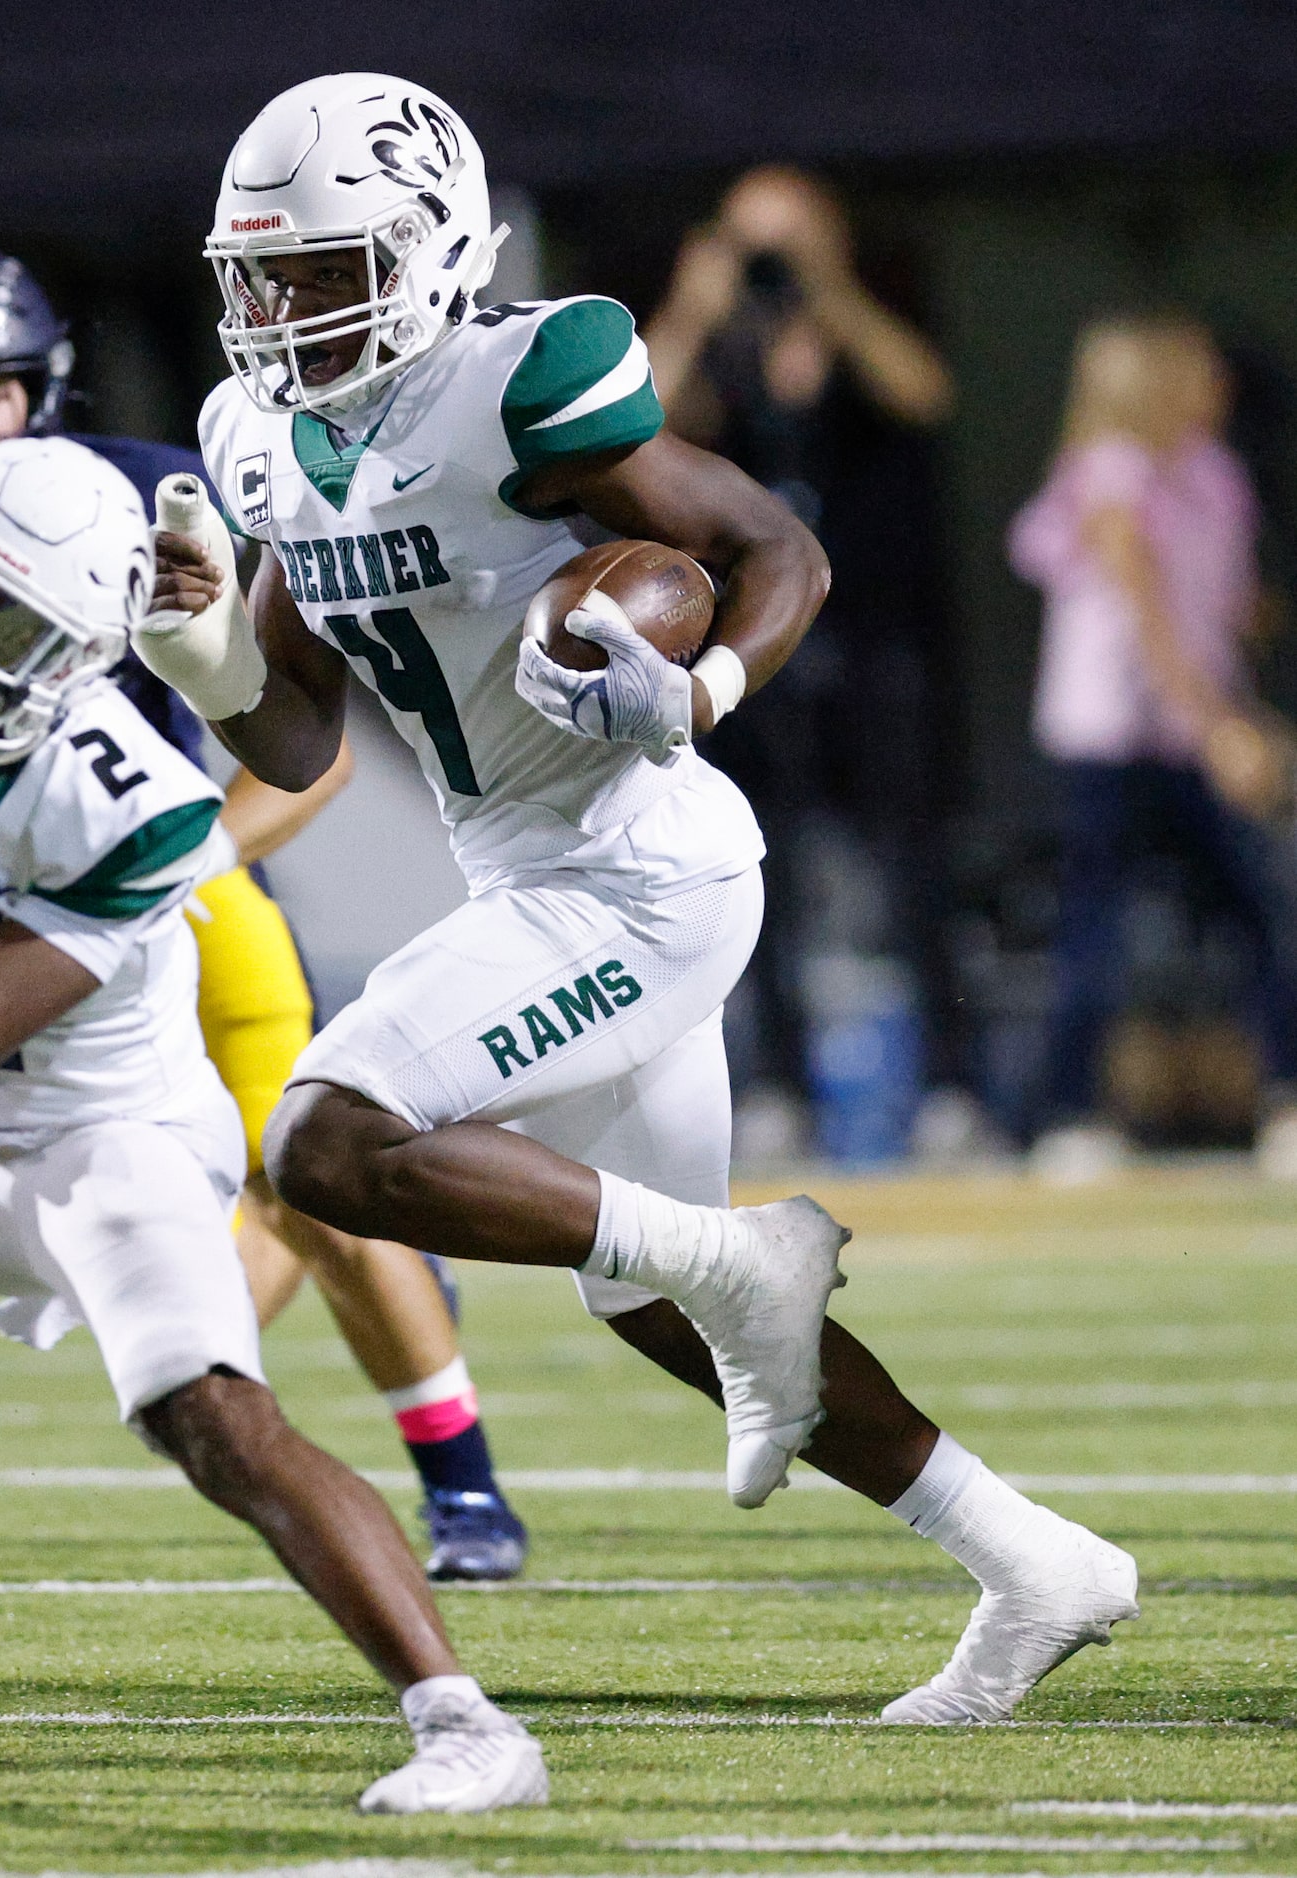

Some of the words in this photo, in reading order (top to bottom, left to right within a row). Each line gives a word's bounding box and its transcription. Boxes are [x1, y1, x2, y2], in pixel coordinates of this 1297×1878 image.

[231, 215, 281, 233] Riddell
[279, 524, 452, 603] BERKNER
[323, 607, 483, 797] 4
[69, 728, 150, 801] 2
[476, 959, 643, 1080] RAMS
